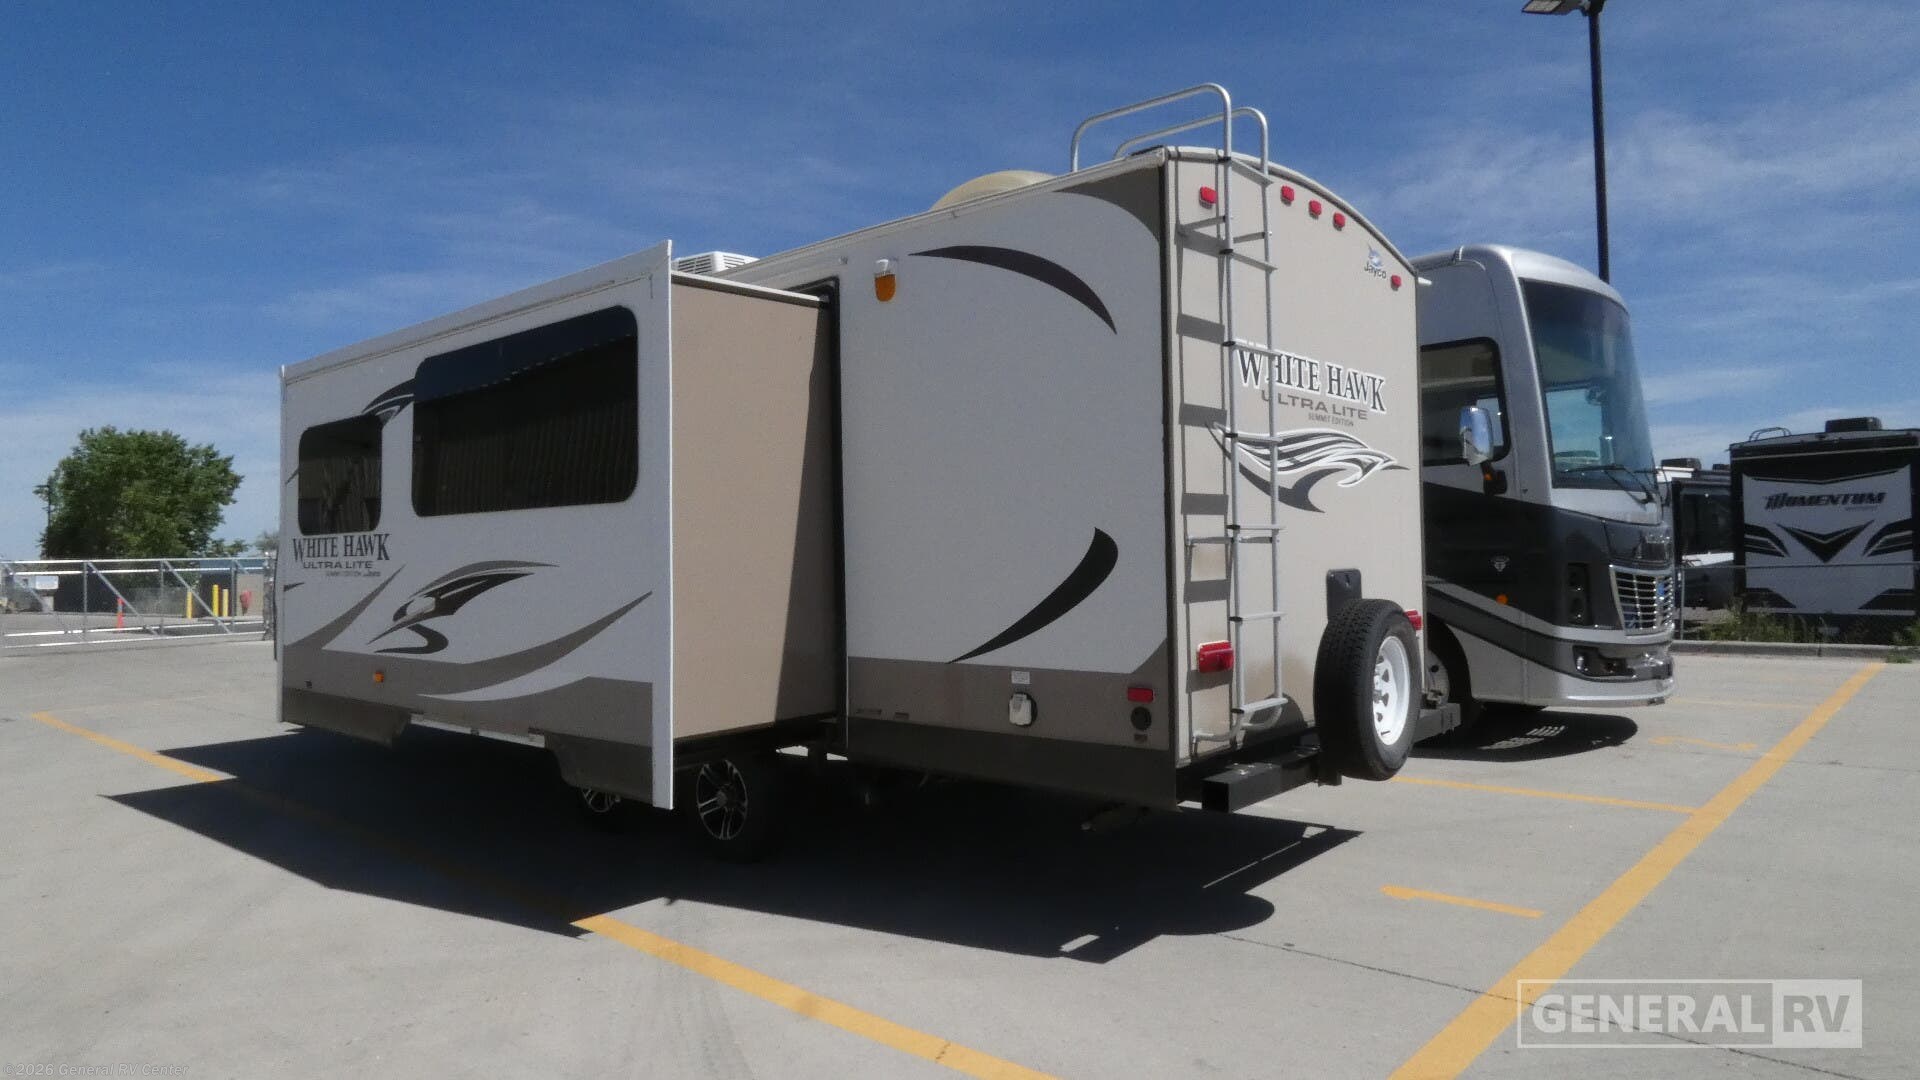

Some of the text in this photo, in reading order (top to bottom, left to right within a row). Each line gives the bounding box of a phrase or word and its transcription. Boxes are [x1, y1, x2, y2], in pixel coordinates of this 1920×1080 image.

[1237, 347, 1386, 412] WHITE HAWK
[1332, 403, 1368, 421] LITE
[1764, 492, 1887, 510] MOMENTUM
[293, 533, 391, 562] WHITE HAWK
[303, 560, 374, 569] ULTRA LITE
